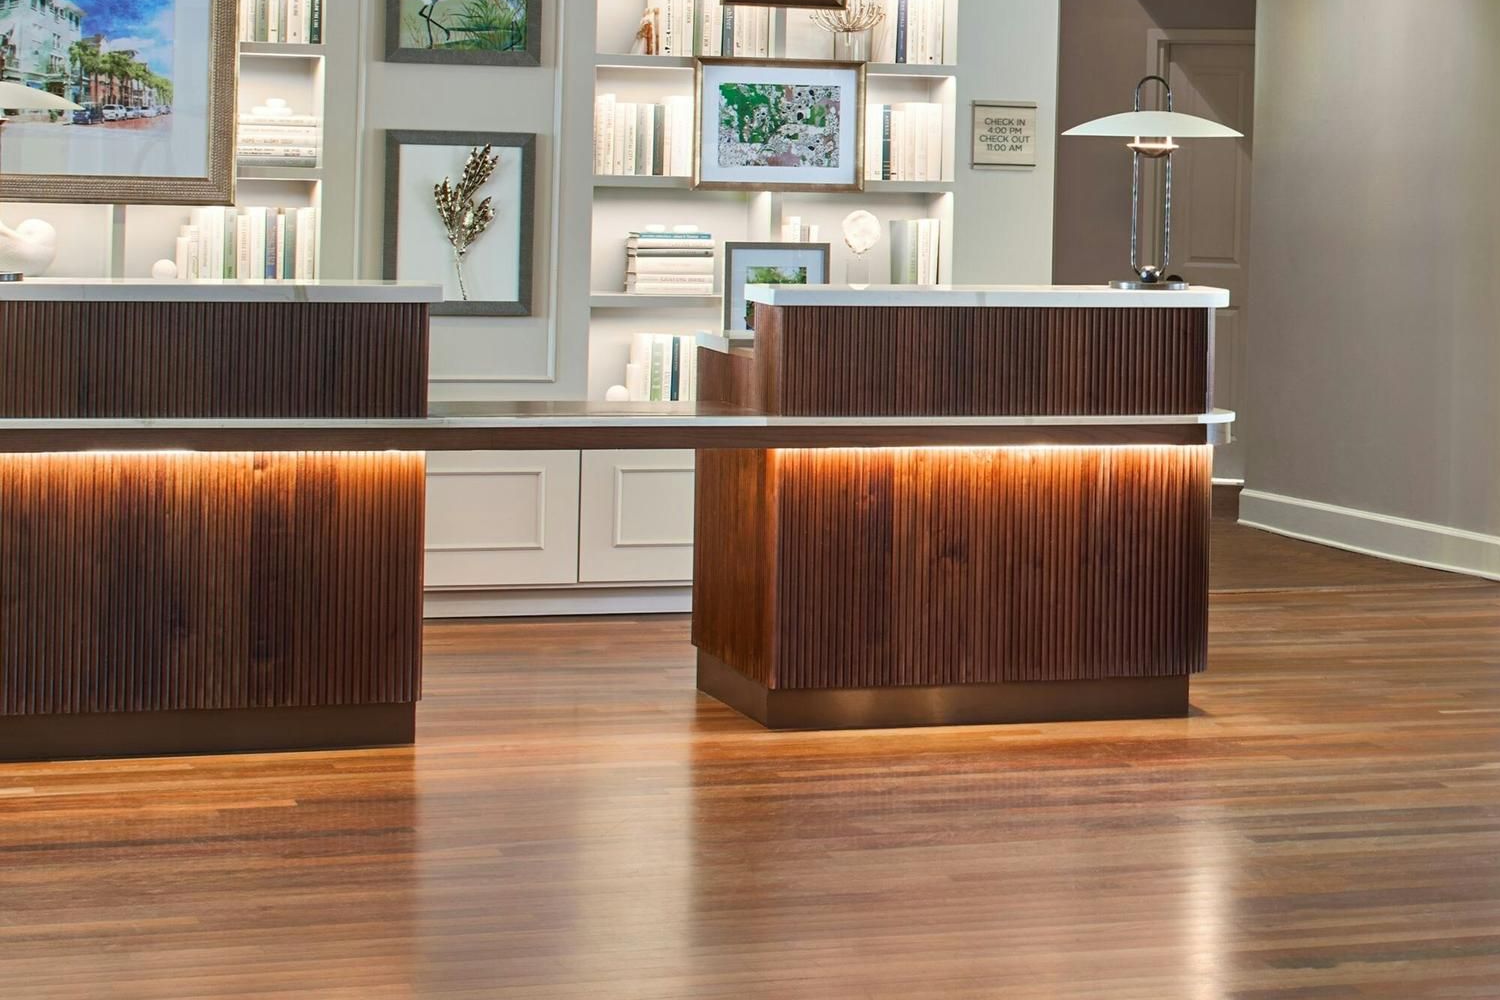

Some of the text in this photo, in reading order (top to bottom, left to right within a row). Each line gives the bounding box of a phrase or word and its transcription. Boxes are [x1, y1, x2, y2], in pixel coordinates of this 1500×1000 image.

[984, 117, 1026, 127] CHECK IN
[987, 126, 1007, 134] 4:00
[979, 135, 1031, 144] CHECK OUT
[987, 143, 1023, 152] 11:00 AM
